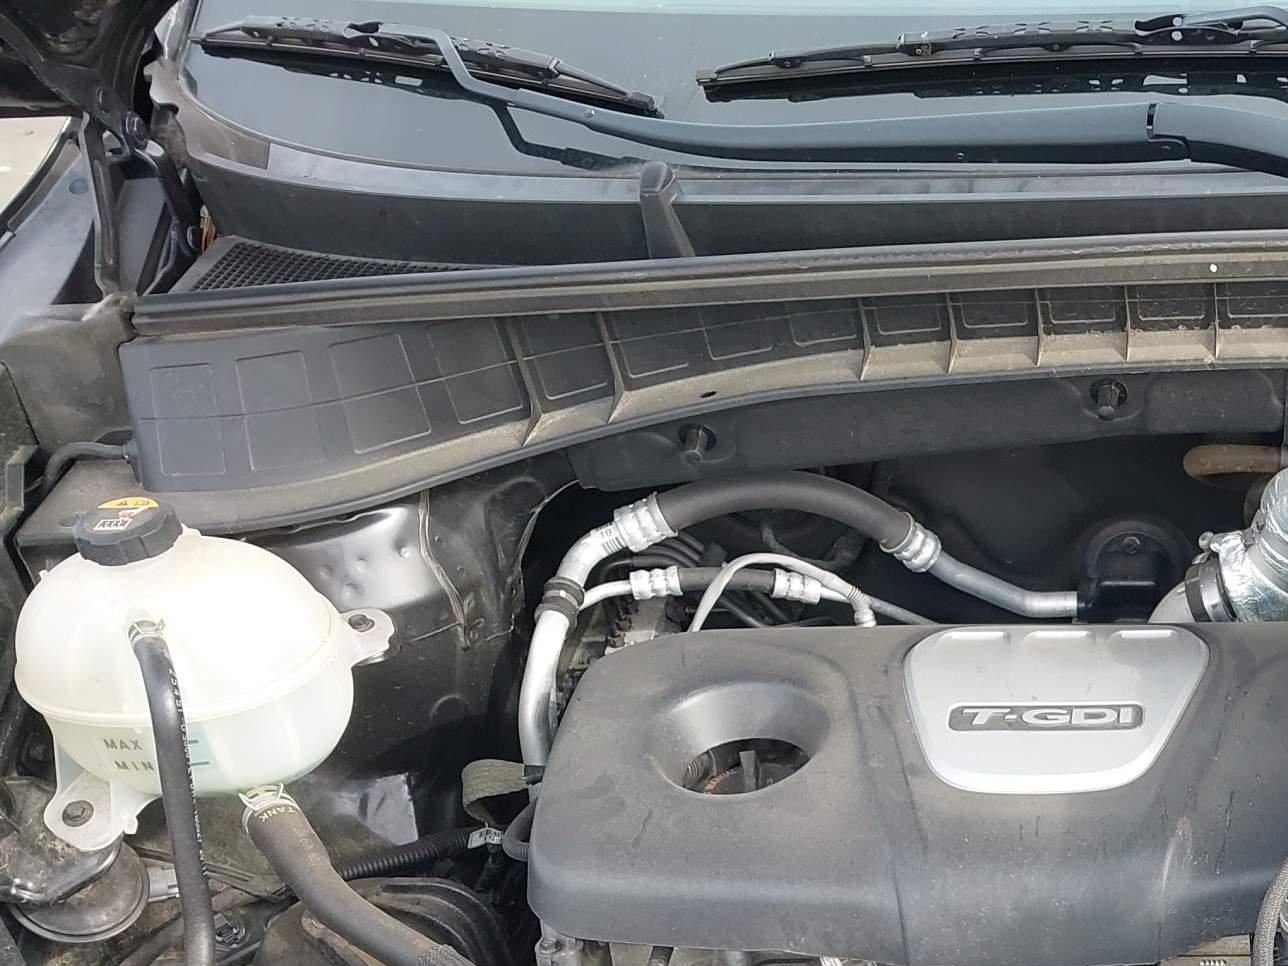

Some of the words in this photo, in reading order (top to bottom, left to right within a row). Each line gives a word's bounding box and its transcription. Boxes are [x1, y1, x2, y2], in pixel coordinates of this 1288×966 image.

[962, 707, 1134, 726] T-GDI
[102, 738, 144, 751] MAX
[114, 760, 155, 771] MIN
[257, 805, 297, 824] TANK
